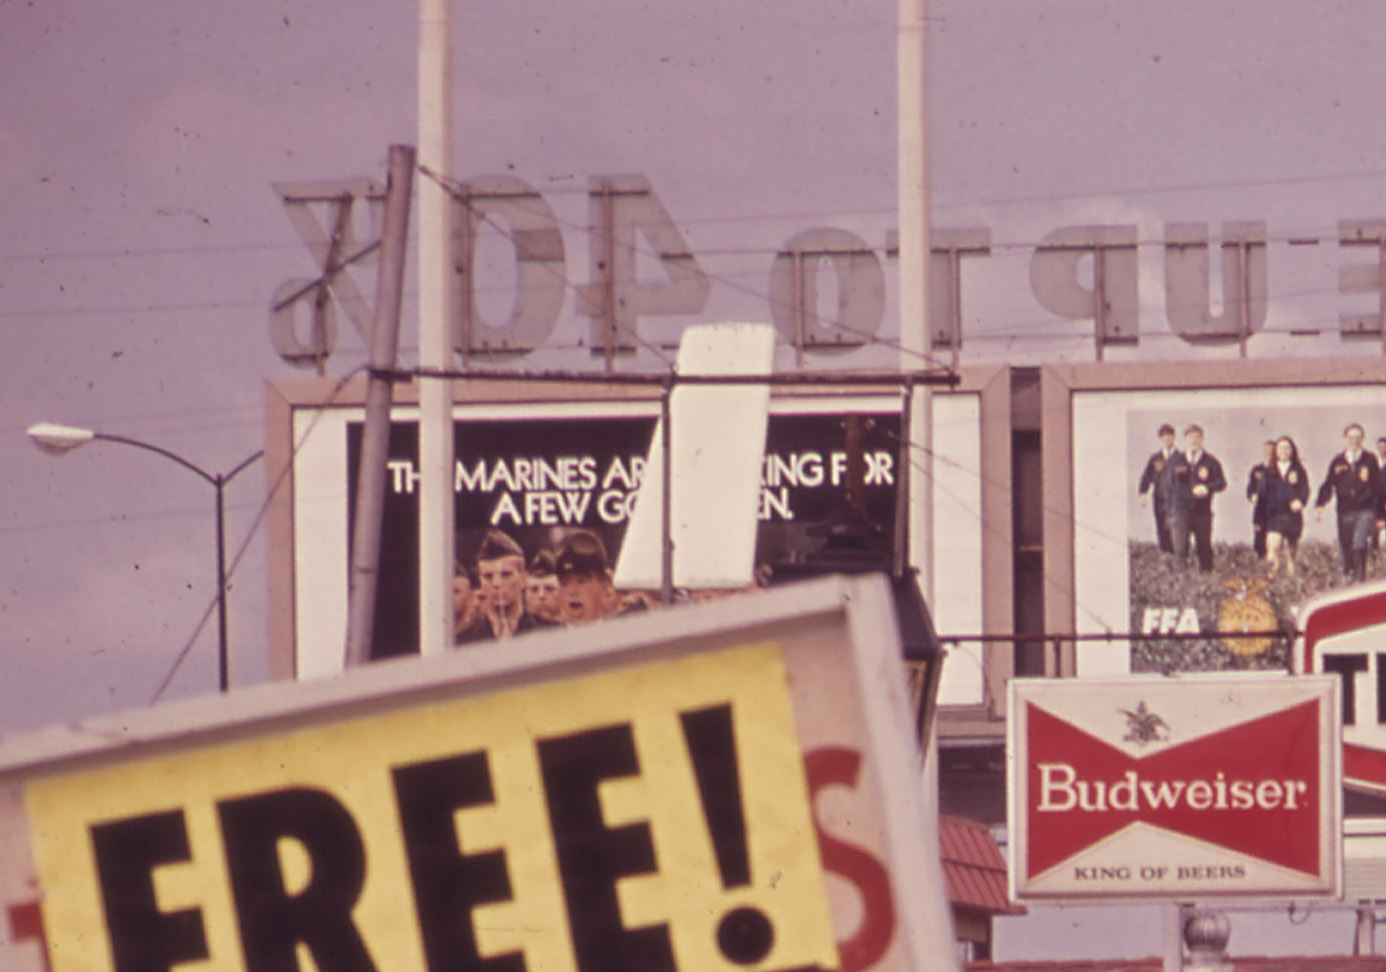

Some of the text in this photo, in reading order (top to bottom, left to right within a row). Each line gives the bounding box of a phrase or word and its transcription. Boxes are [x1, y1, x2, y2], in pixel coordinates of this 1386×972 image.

[387, 460, 421, 494] TH
[454, 457, 597, 492] MARINES
[602, 457, 646, 489] AR
[490, 492, 523, 525] A
[525, 491, 592, 524] FEW
[1142, 607, 1201, 635] FFA
[1036, 762, 1308, 812] Budweiser
[1074, 864, 1247, 881] KING OF BEERS
